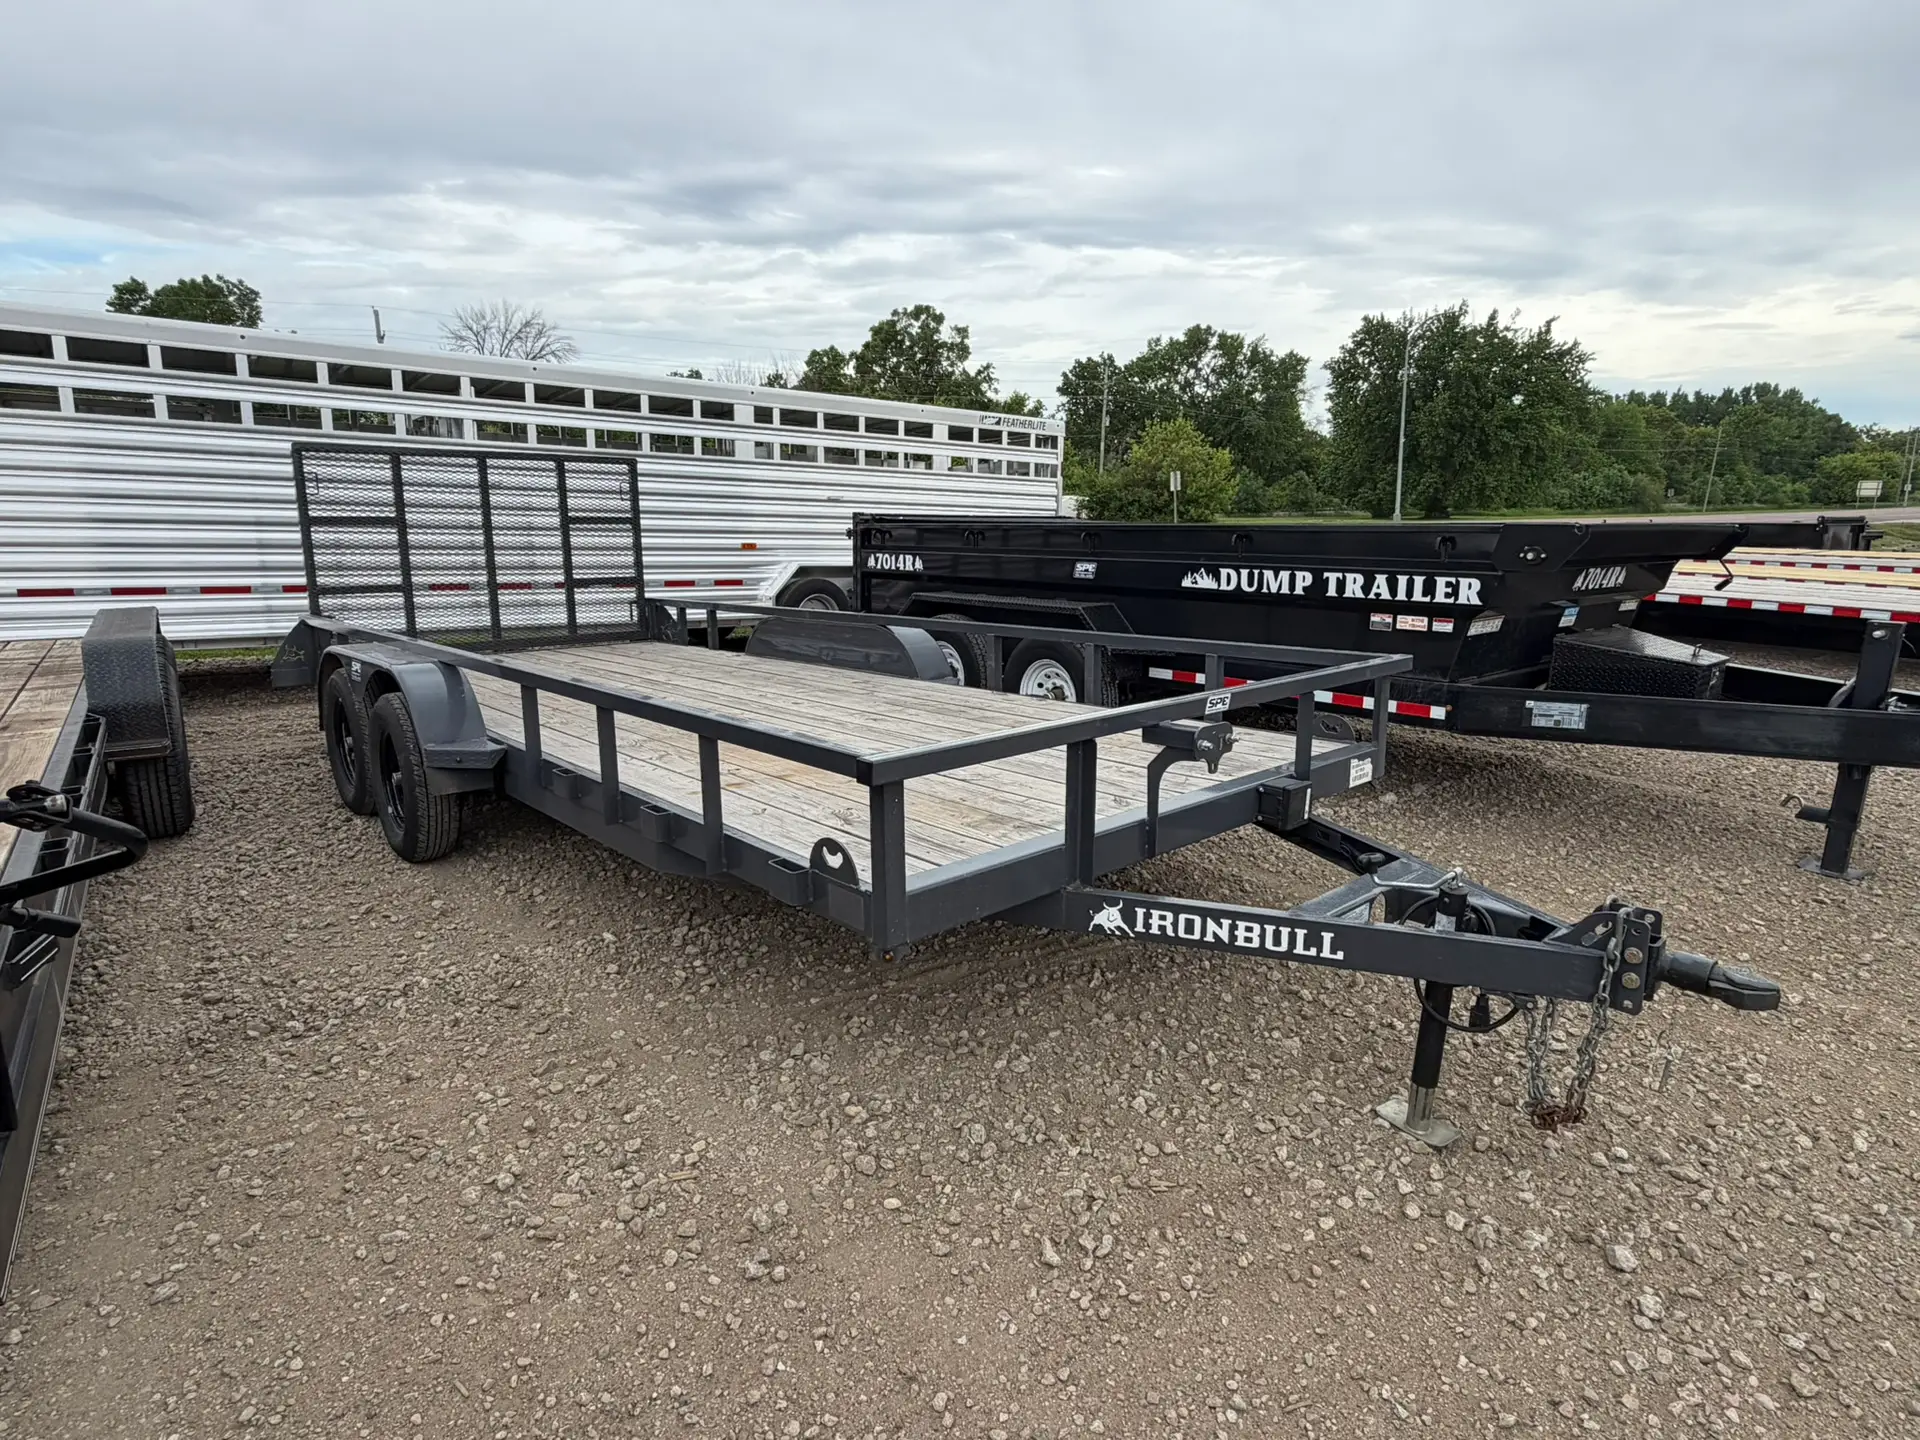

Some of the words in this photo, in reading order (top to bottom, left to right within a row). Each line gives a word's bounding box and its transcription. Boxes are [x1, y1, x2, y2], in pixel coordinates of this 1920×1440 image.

[1002, 417, 1047, 430] FEATHERLITE
[876, 553, 914, 571] 7014R
[1075, 563, 1096, 572] SPE
[1218, 568, 1313, 595] DUMP
[1323, 572, 1483, 606] TRAILER
[1580, 566, 1621, 591] 7014R
[1208, 696, 1229, 708] SPE
[1134, 907, 1344, 960] IRONBULL
